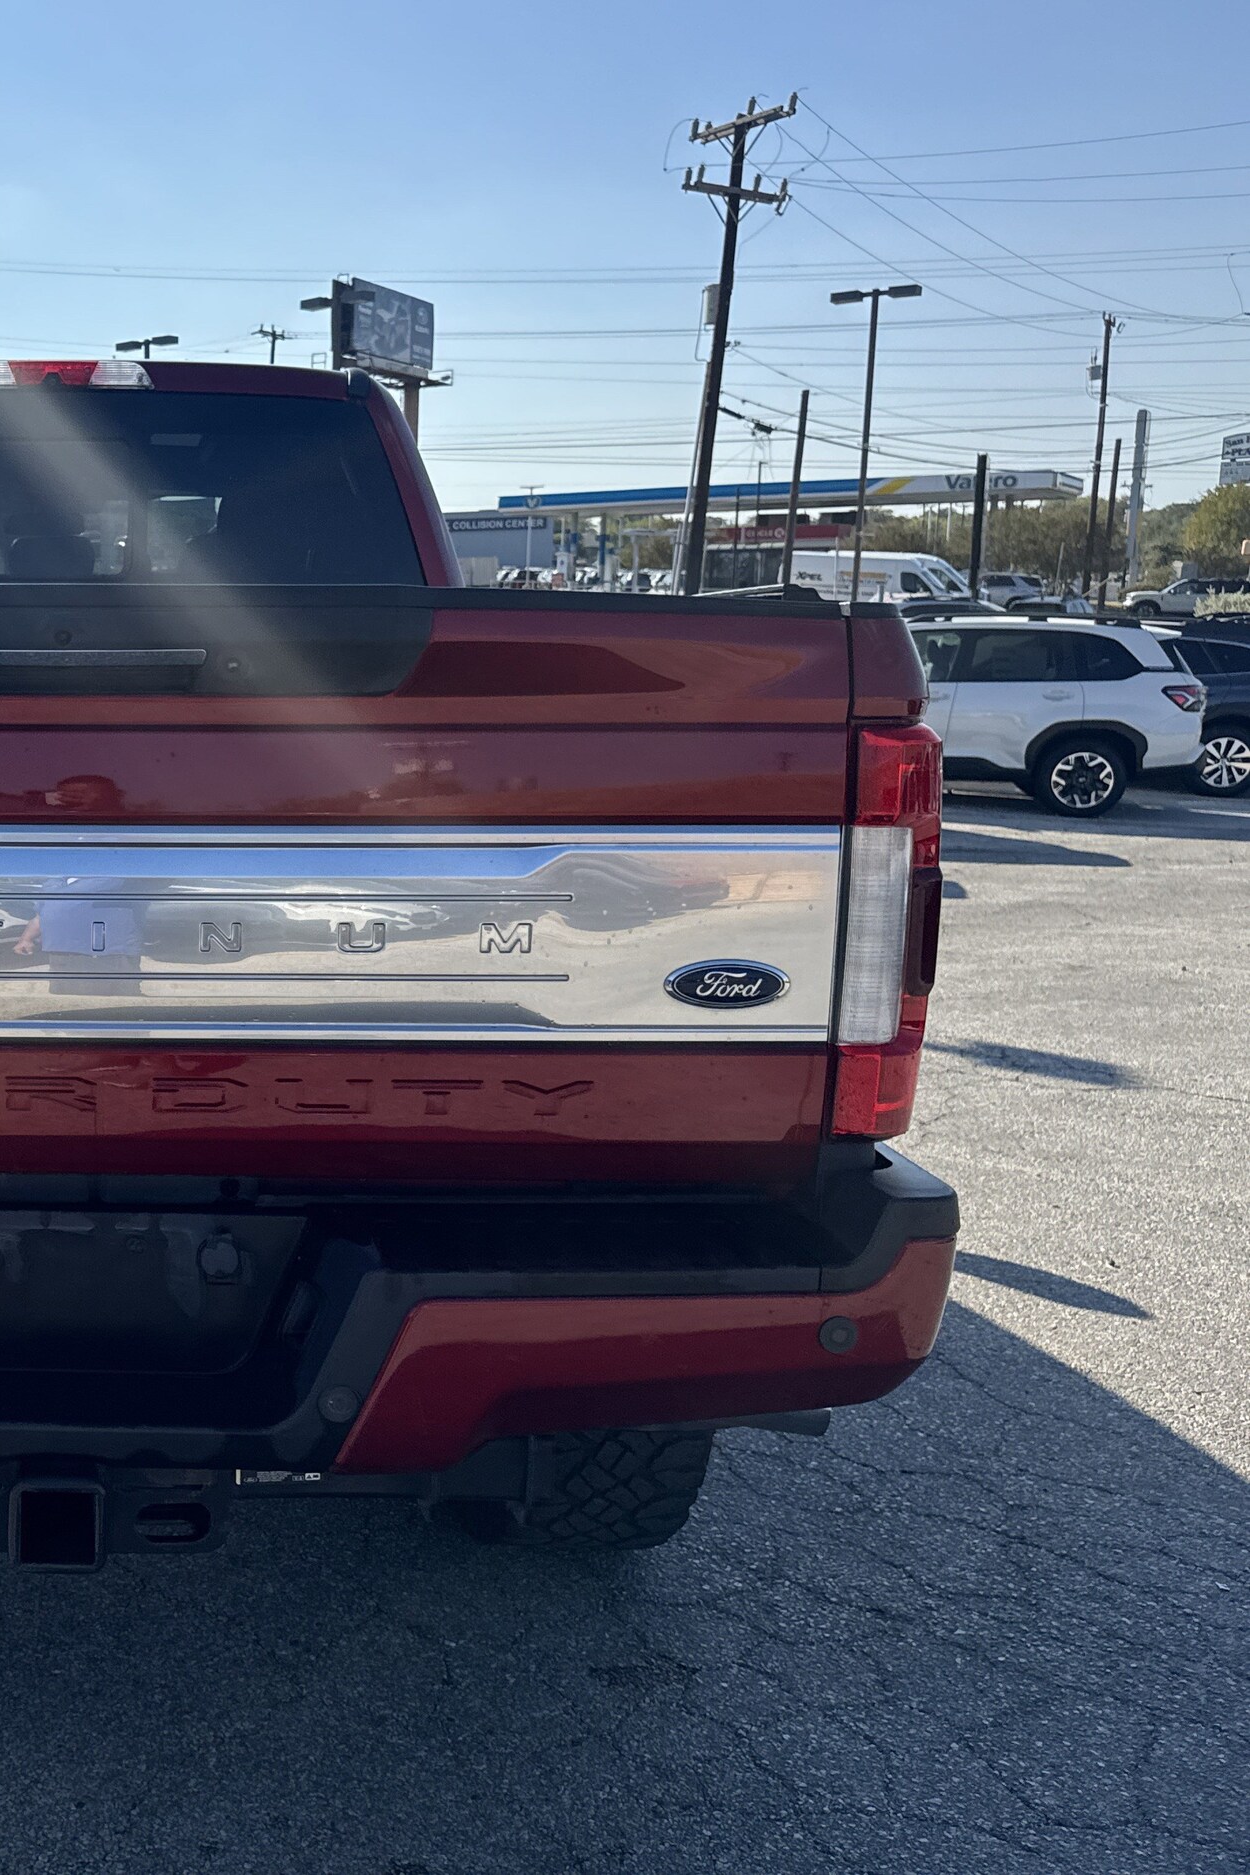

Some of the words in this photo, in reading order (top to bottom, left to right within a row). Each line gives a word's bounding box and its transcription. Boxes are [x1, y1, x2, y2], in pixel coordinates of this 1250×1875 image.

[945, 474, 1017, 489] Valro
[452, 520, 504, 530] COLLISION
[505, 518, 544, 529] CENTER
[695, 971, 763, 998] Ford
[151, 1077, 594, 1116] DUTY
